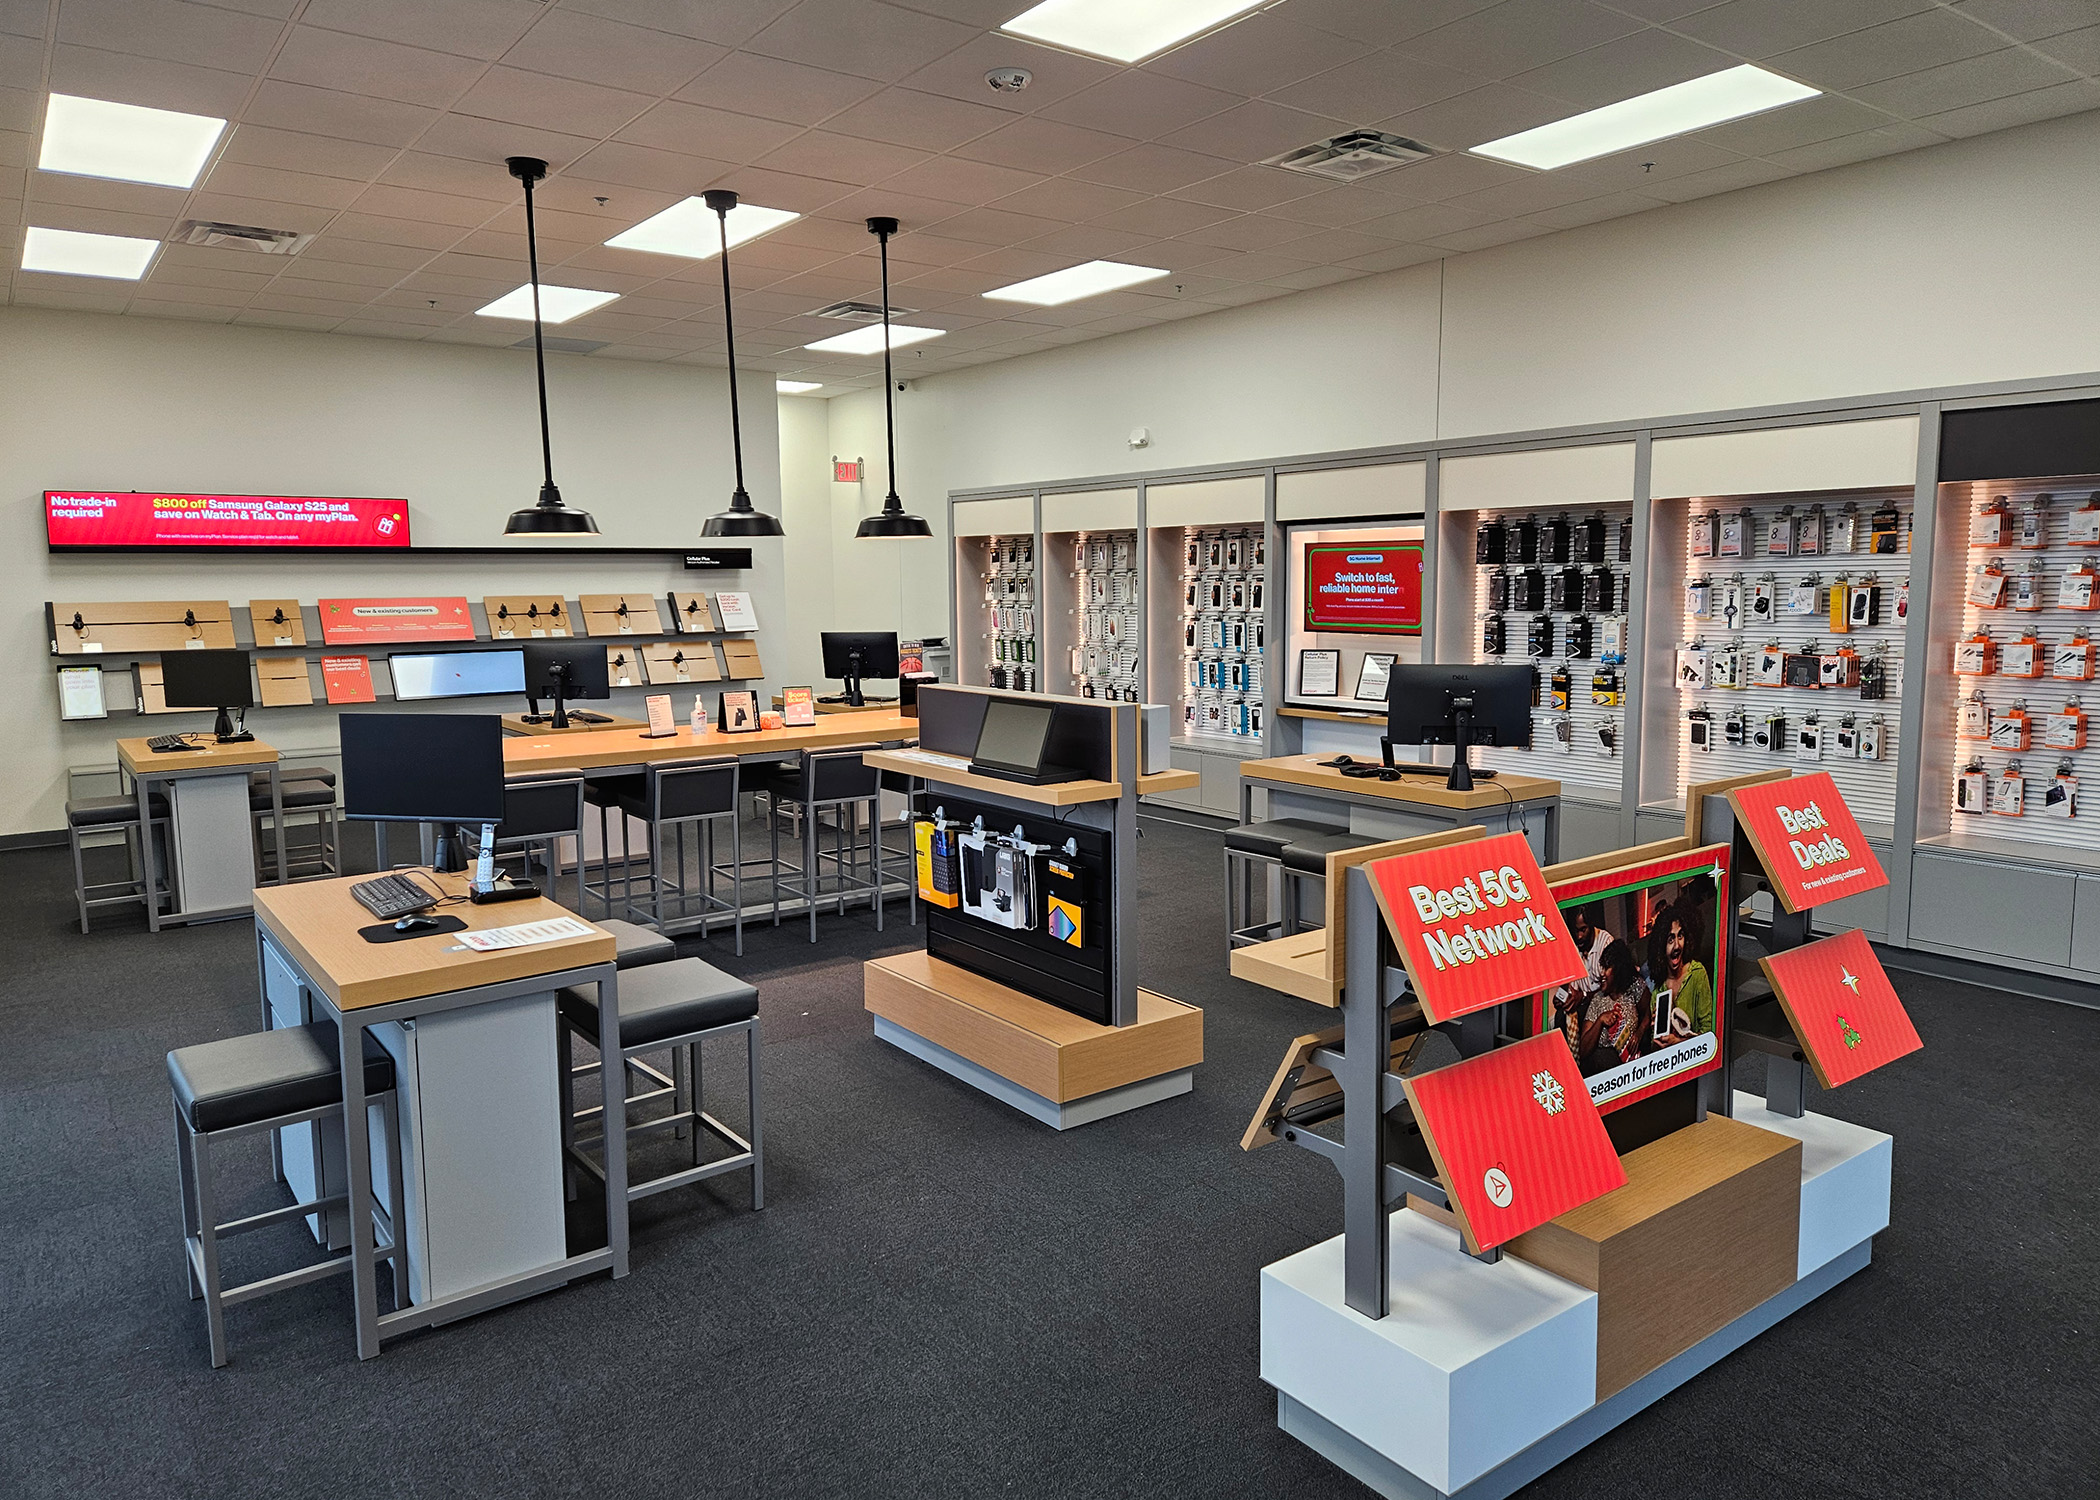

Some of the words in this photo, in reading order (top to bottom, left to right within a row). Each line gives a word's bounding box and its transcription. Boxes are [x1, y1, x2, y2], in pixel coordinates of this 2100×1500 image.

[838, 463, 857, 481] EXIT
[51, 496, 69, 506] No
[70, 496, 117, 507] trade-in
[153, 497, 188, 509] $800
[190, 499, 207, 509] off
[208, 499, 263, 511] Samsung
[264, 500, 303, 512] Galaxy
[304, 501, 327, 511] S25
[328, 502, 350, 511] and
[52, 507, 103, 519] required
[154, 511, 183, 519] save
[184, 511, 200, 519] on
[201, 509, 239, 519] Watch
[240, 510, 249, 520] &
[251, 511, 275, 520] Tab.
[275, 511, 293, 520] On
[294, 513, 314, 523] any
[315, 512, 359, 523] myPlan.
[1335, 572, 1364, 582] Switch
[1365, 572, 1375, 582] to
[1375, 572, 1396, 584] fast,
[1319, 583, 1350, 593] reliable
[1351, 584, 1376, 593] home
[1775, 800, 1829, 835] Best
[1788, 832, 1850, 871] Deals
[1801, 882, 1812, 890] For
[1811, 879, 1822, 888] new
[1824, 873, 1844, 884] existing
[1842, 867, 1867, 879] customers
[1408, 876, 1488, 925] Best
[1478, 865, 1532, 908] 5G
[1421, 907, 1557, 972] Network
[1590, 1073, 1630, 1098] season
[1632, 1066, 1648, 1082] for
[1649, 1059, 1670, 1075] free
[1670, 1043, 1708, 1070] phones
